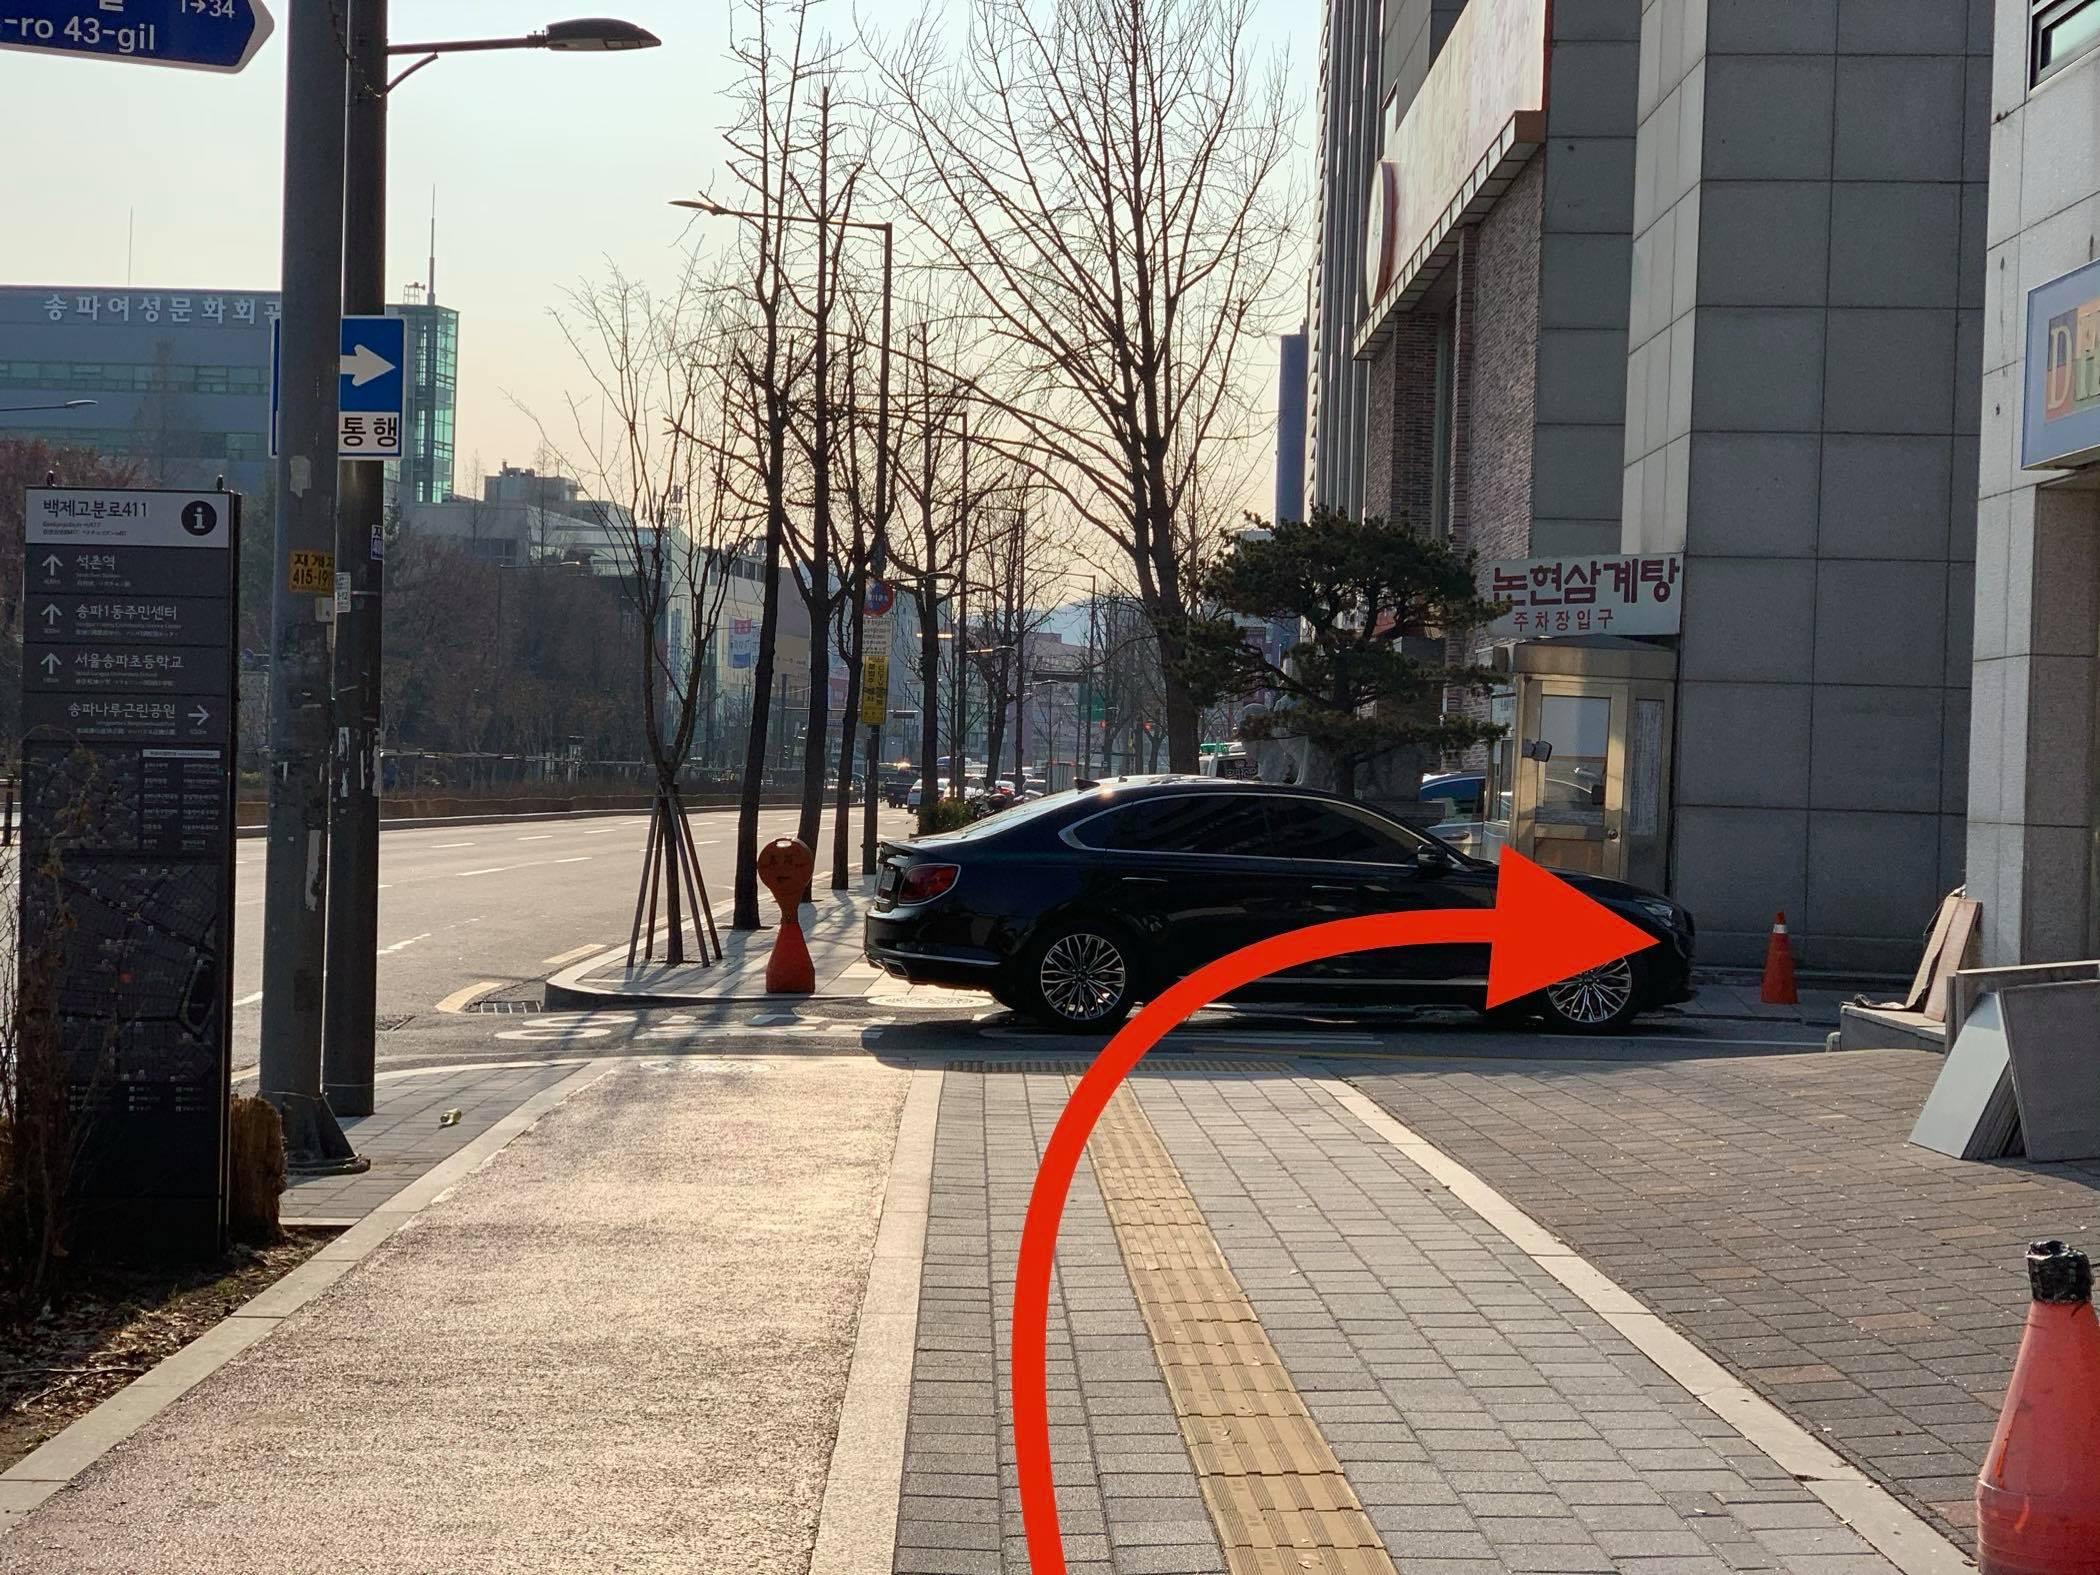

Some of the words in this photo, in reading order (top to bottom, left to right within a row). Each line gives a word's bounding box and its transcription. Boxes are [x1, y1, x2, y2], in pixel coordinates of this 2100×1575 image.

[64, 15, 155, 53] 43-gil
[340, 416, 398, 447] 통행
[43, 500, 148, 519] 백제고분로411
[76, 554, 115, 570] 석촌역
[1493, 557, 1680, 606] 논현삼계탕
[75, 604, 177, 620] 송파1동주민센터
[1513, 608, 1613, 632] 주차장입구
[74, 652, 184, 670] 서울송파초등학교
[68, 702, 176, 719] 송파나루근린공원
